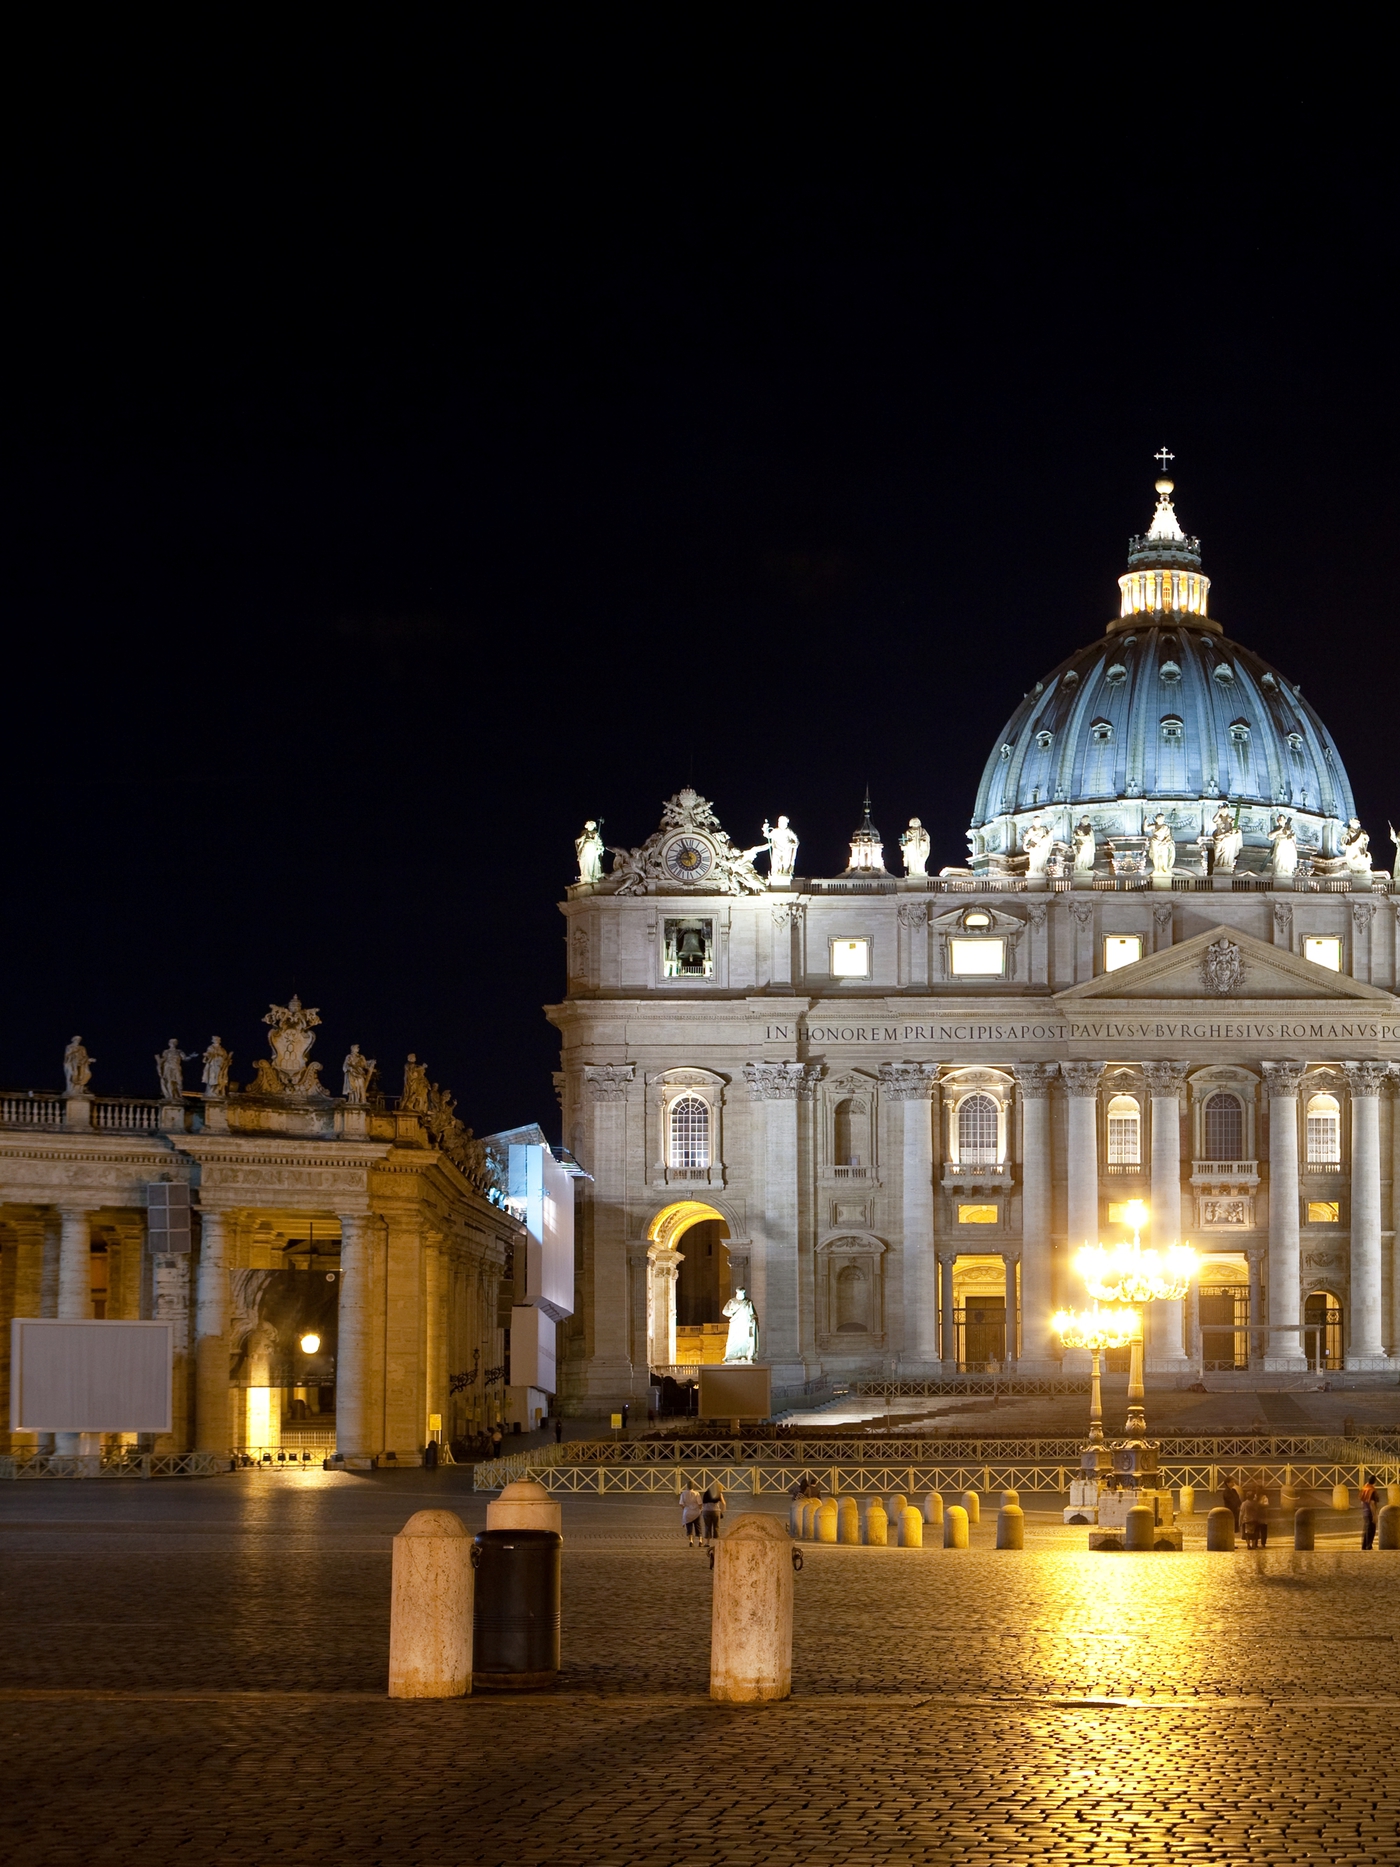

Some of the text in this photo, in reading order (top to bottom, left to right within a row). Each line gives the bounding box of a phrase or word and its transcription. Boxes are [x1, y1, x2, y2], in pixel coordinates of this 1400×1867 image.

[765, 1026, 789, 1038] IN
[798, 1027, 898, 1041] HONOREM
[904, 1025, 1003, 1040] PRINCIPIS
[1007, 1024, 1067, 1039] APOST
[1070, 1023, 1135, 1038] PAVLVS
[1138, 1024, 1151, 1037] V
[1155, 1023, 1275, 1038] BVRGHESIVS
[1280, 1023, 1378, 1038] ROMANVS
